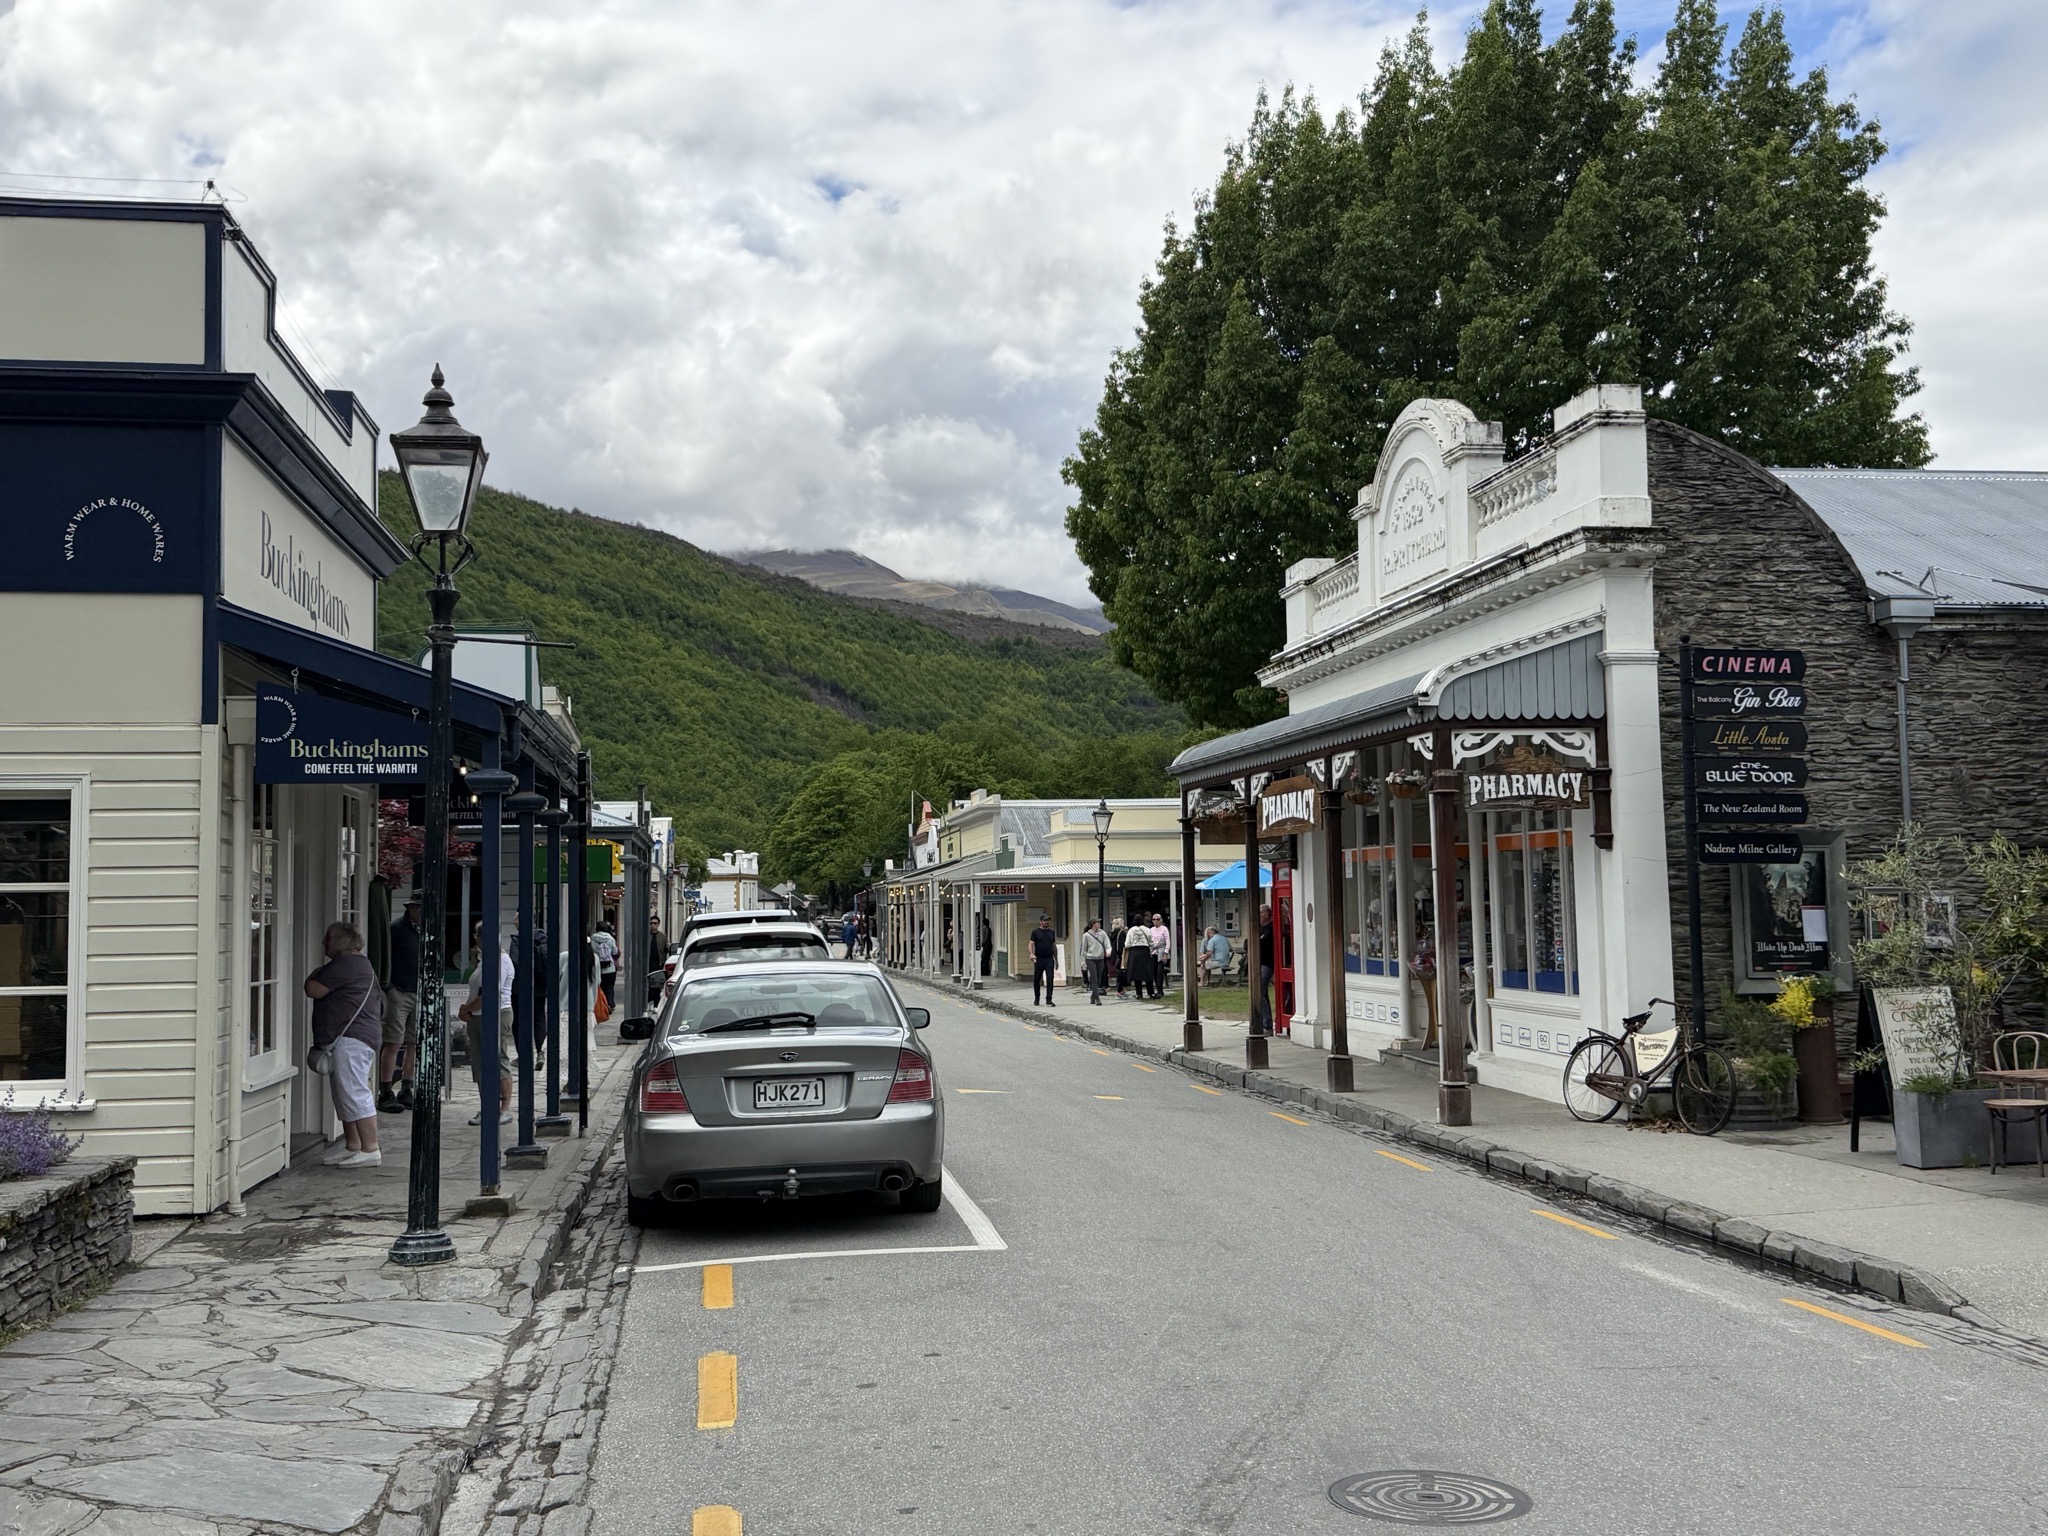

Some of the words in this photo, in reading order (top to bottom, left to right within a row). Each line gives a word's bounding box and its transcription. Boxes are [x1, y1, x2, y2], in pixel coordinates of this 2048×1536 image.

[64, 522, 77, 560] WARM
[73, 499, 107, 521] WEAR
[109, 497, 118, 506] &
[121, 498, 155, 523] HOME
[152, 522, 165, 563] WARES
[261, 510, 350, 640] Buckinghams
[1702, 656, 1792, 674] CINEMA
[263, 695, 284, 703] WARM
[1731, 687, 1762, 714] Gin
[1765, 687, 1802, 708] Bar
[284, 700, 297, 716] WEAR
[282, 722, 297, 739] HOME
[1710, 724, 1750, 745] Little
[1748, 725, 1789, 745] Aosta
[290, 738, 429, 762] Buckinghams
[304, 763, 331, 774] COME
[333, 763, 355, 774] FEEL
[357, 763, 374, 774] THE
[376, 763, 418, 774] WARMTH
[1706, 770, 1748, 782] BLUE
[1750, 771, 1796, 784] DOOR
[1468, 773, 1582, 806] PHARMACY
[1262, 788, 1315, 831] PHARMACY
[1703, 804, 1720, 813] The
[1722, 804, 1741, 813] New
[1742, 804, 1777, 813] Zealand
[1779, 804, 1802, 813] Room
[1705, 844, 1736, 853] Nadene
[1739, 844, 1764, 853] Milne
[1766, 844, 1798, 856] Gallery
[983, 886, 1000, 895] THE
[1001, 885, 1025, 894] SHED
[1755, 942, 1776, 952] Wake
[1776, 942, 1787, 953] Up
[1788, 941, 1805, 952] Dead
[757, 1084, 819, 1102] HJK271
